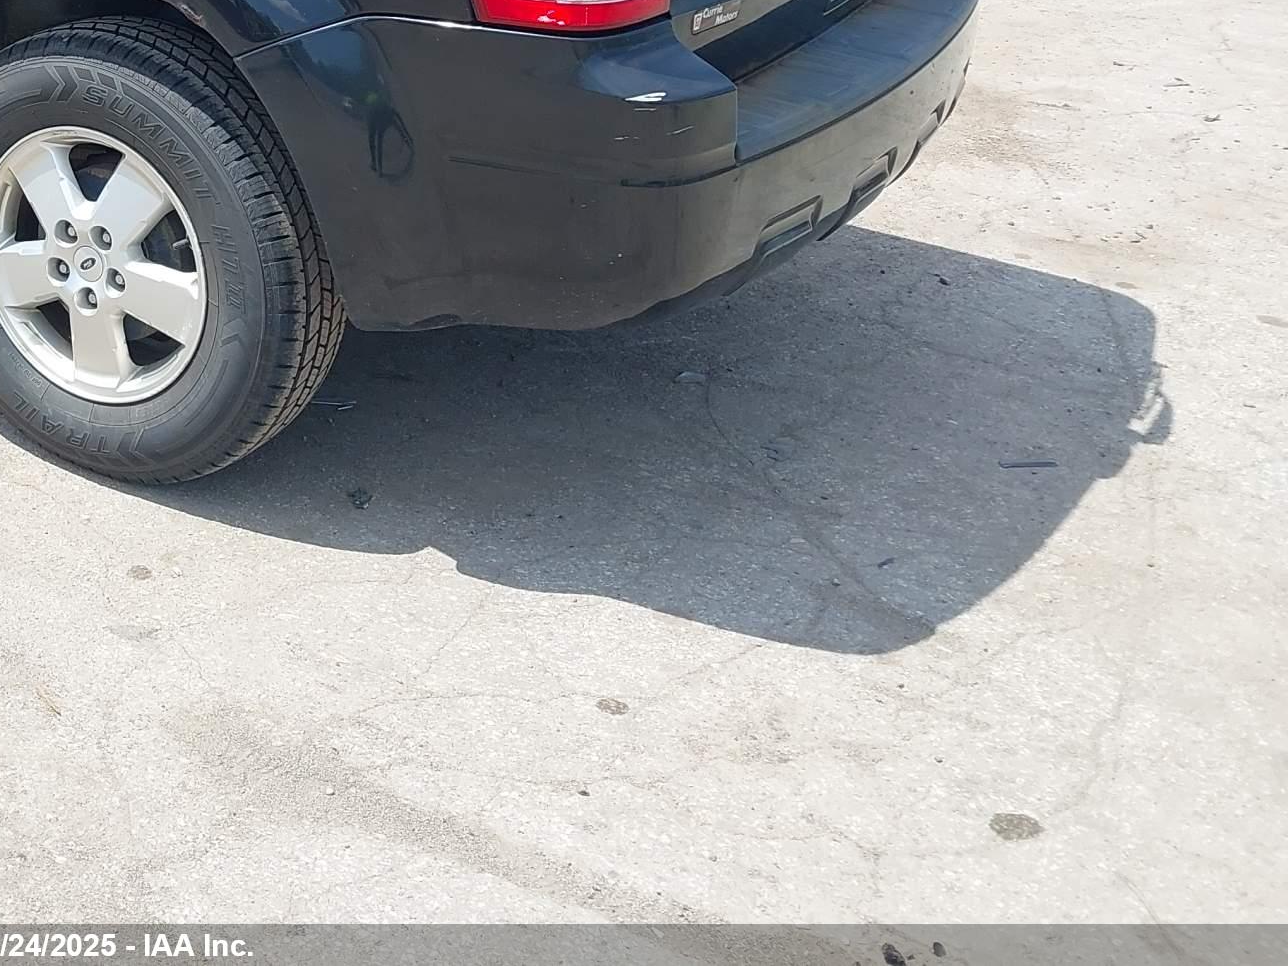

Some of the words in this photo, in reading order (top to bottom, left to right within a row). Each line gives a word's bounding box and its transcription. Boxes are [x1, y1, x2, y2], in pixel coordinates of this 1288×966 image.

[714, 10, 739, 25] Motors
[80, 85, 223, 209] SUMMIT
[13, 390, 112, 454] TRAIL
